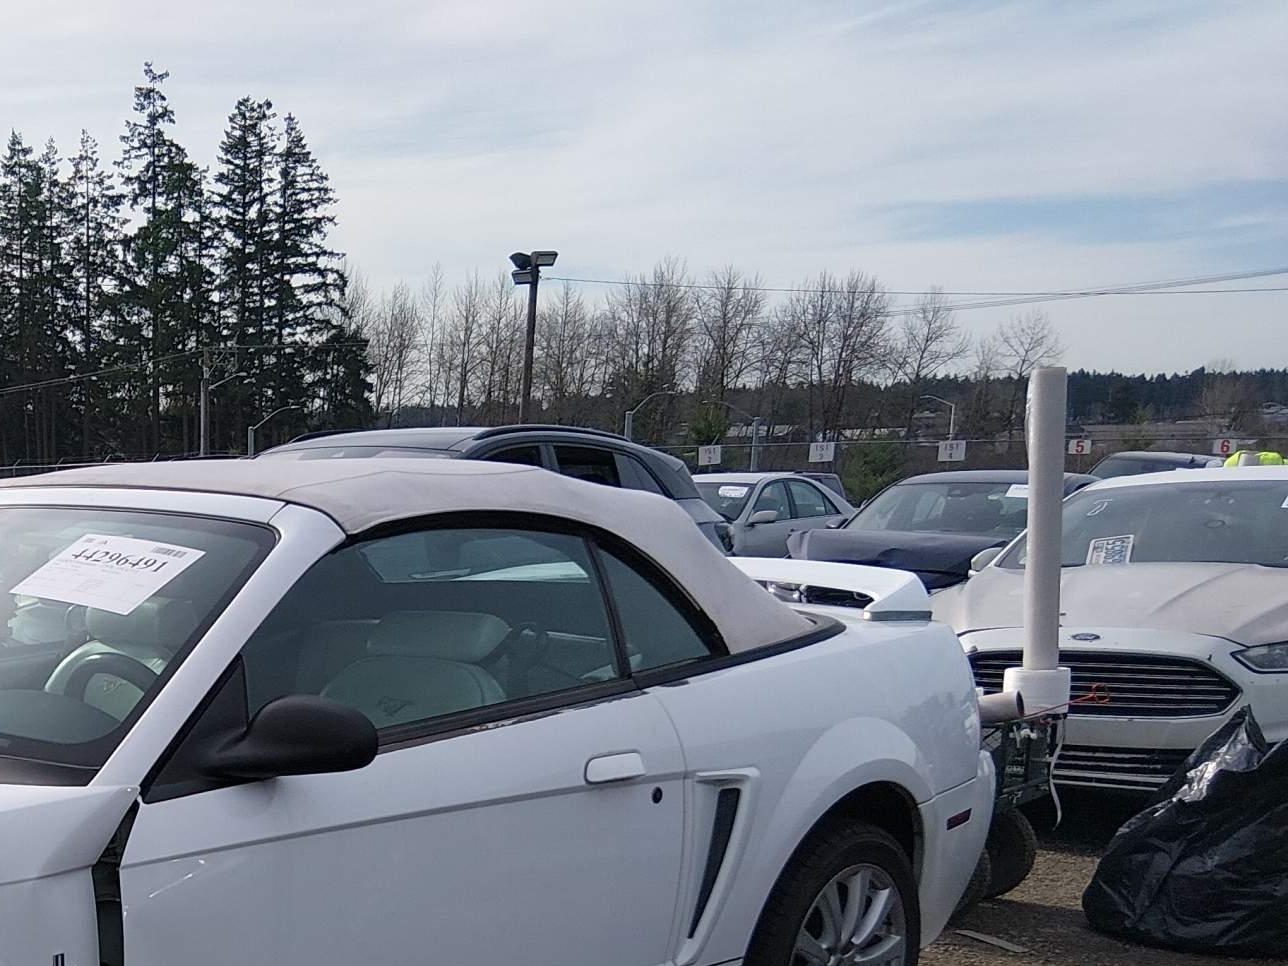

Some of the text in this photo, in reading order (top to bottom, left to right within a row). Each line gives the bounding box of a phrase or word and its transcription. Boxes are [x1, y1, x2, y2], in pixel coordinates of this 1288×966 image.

[1075, 439, 1084, 453] 5
[1221, 439, 1230, 453] 6
[72, 549, 169, 573] 44296491
